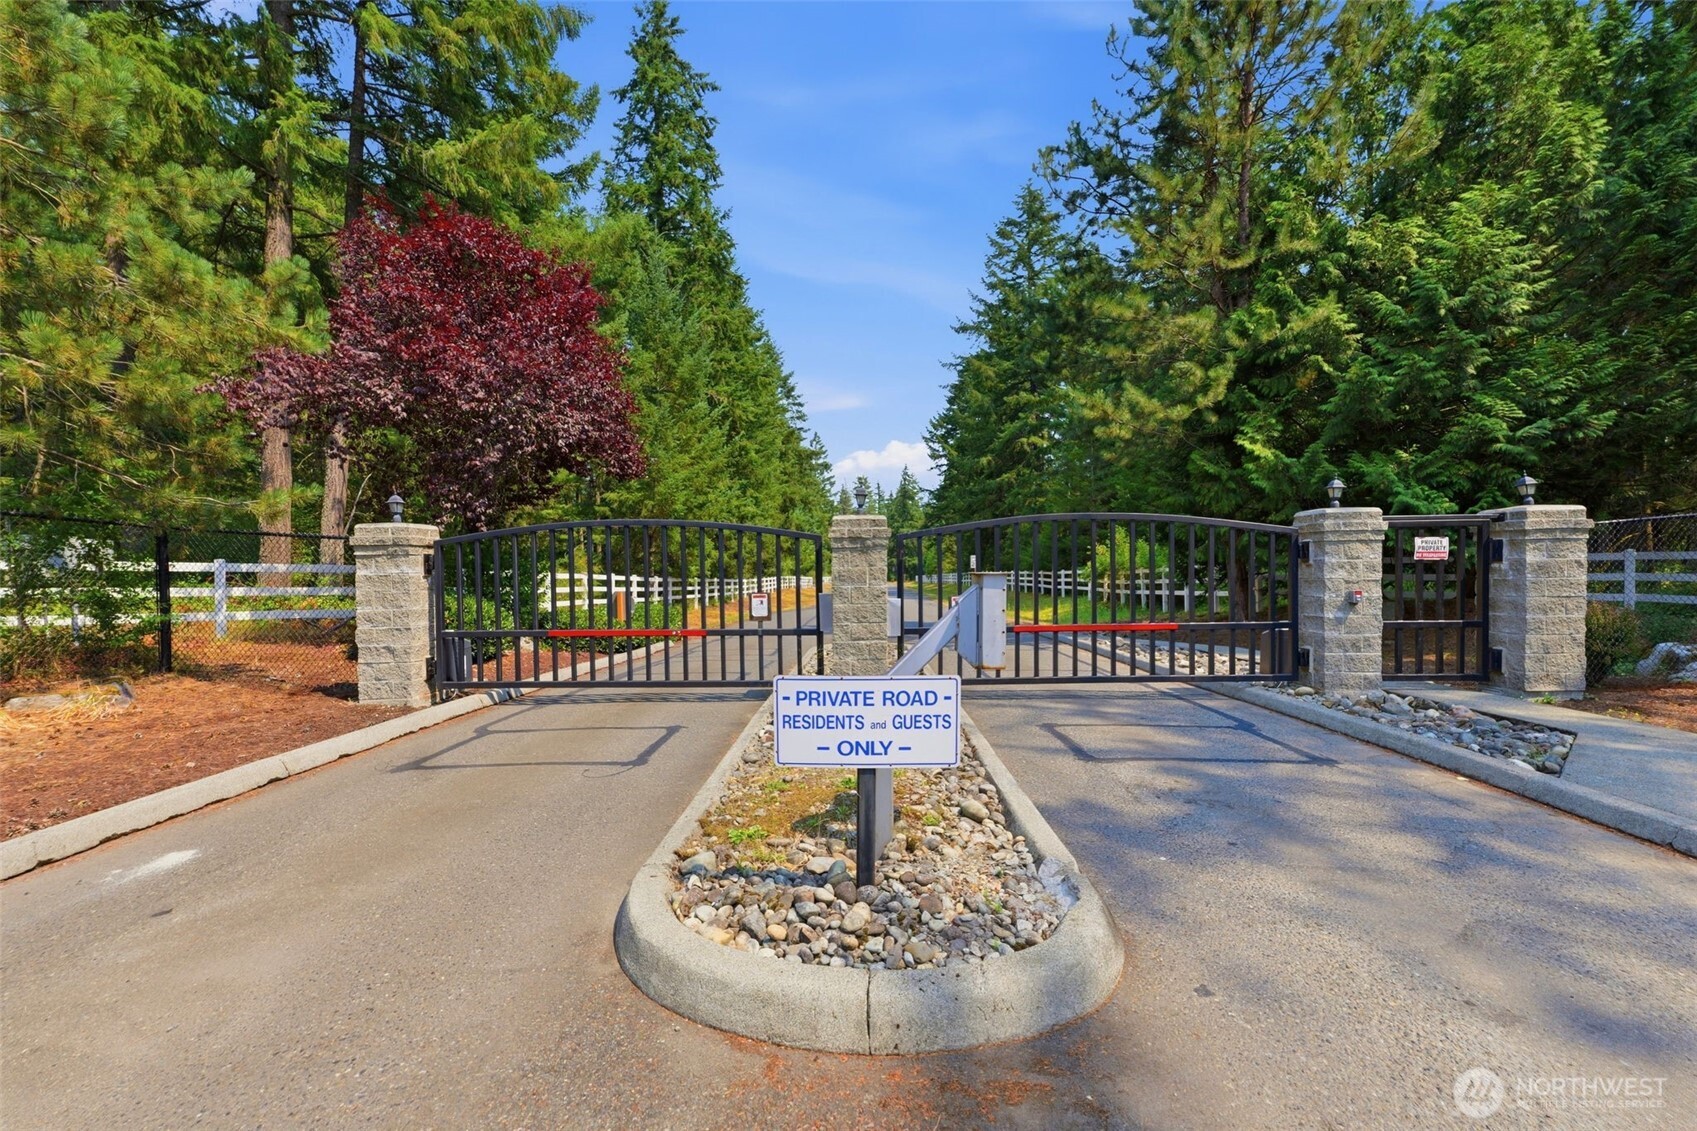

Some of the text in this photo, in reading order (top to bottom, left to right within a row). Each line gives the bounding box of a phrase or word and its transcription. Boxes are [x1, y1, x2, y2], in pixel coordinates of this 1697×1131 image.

[795, 690, 875, 707] PRIVATE
[882, 690, 938, 706] ROAD
[782, 714, 952, 730] RESIDENTS and GUESTS
[837, 740, 893, 756] ONLY
